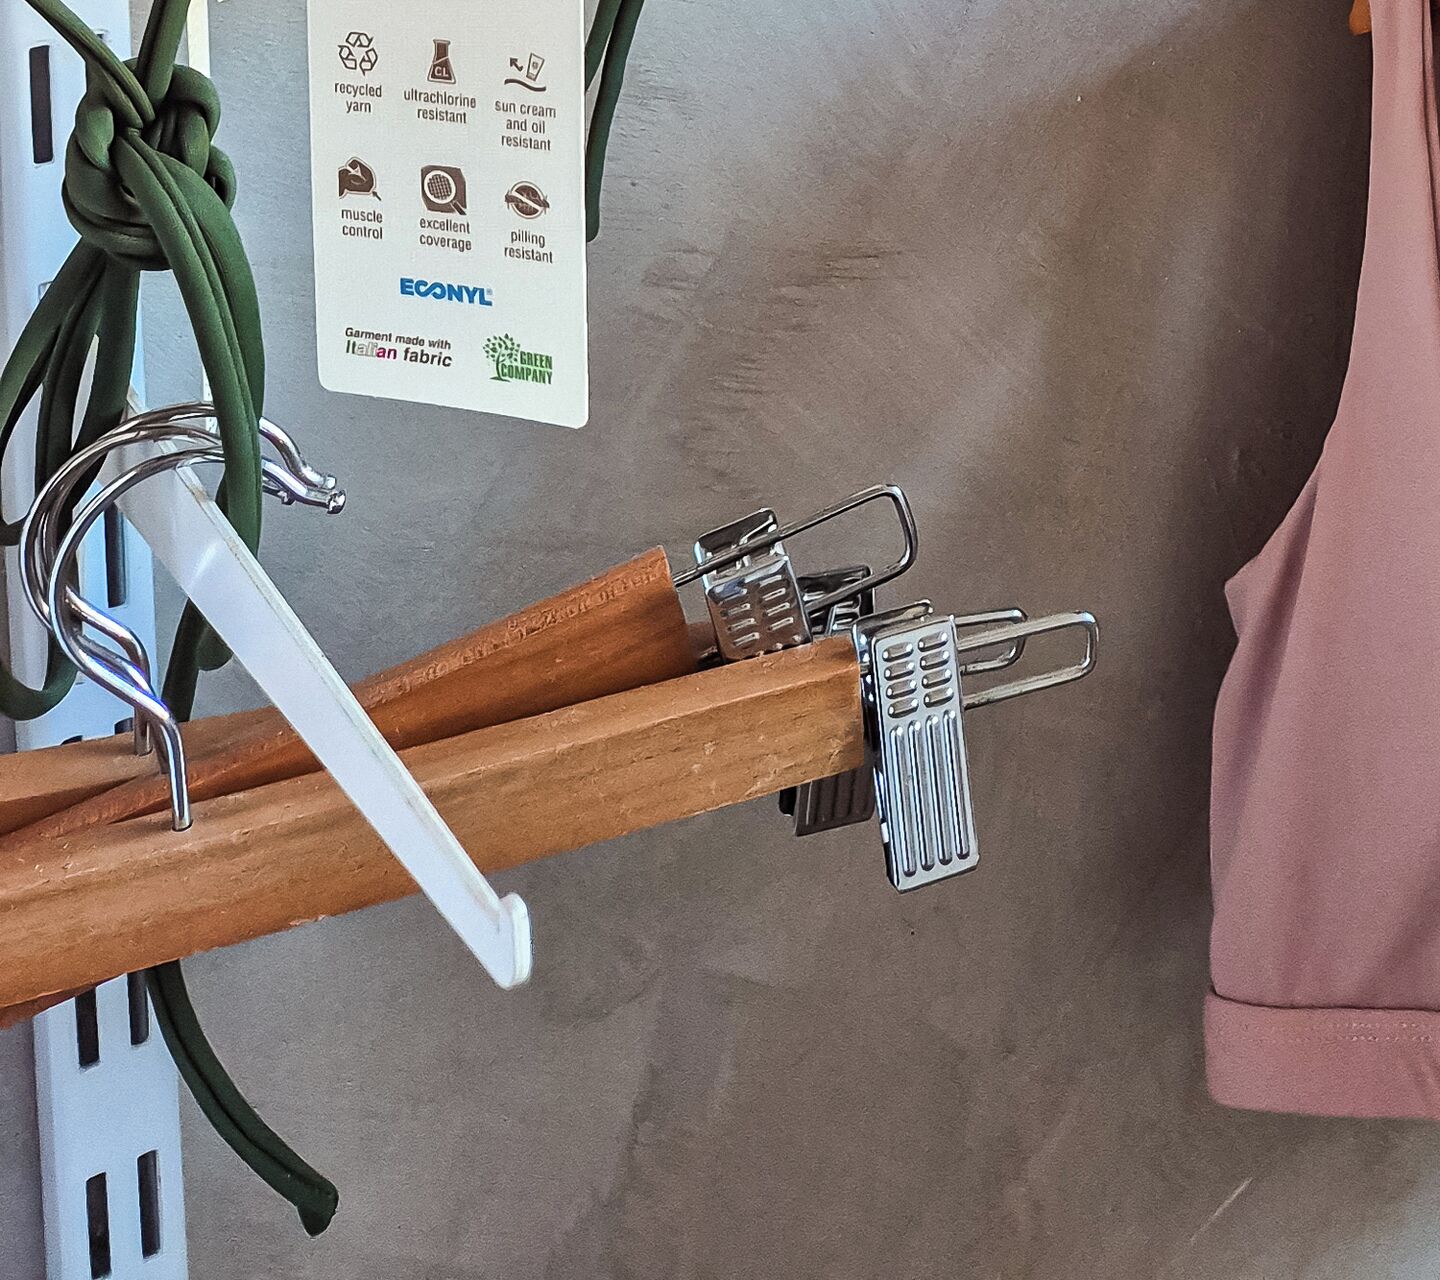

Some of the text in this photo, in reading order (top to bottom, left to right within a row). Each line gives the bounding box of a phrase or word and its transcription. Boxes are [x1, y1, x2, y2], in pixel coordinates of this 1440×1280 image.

[434, 65, 450, 78] CL
[334, 80, 383, 99] recycled
[403, 87, 477, 109] ultrachlorine
[345, 98, 372, 114] yarn
[416, 107, 468, 124] resistant
[494, 99, 557, 119] sun cream
[505, 117, 546, 134] and oil
[500, 133, 552, 152] resistant
[340, 208, 383, 223] muscle
[341, 224, 384, 240] control
[419, 217, 471, 235] excellent
[418, 233, 472, 253] coverage
[510, 229, 546, 248] pilling
[504, 246, 553, 264] resistant
[345, 326, 452, 351] Garment made with
[345, 340, 453, 368] Italian fabric
[519, 350, 553, 370] GREEN
[500, 362, 553, 385] COMPANY
